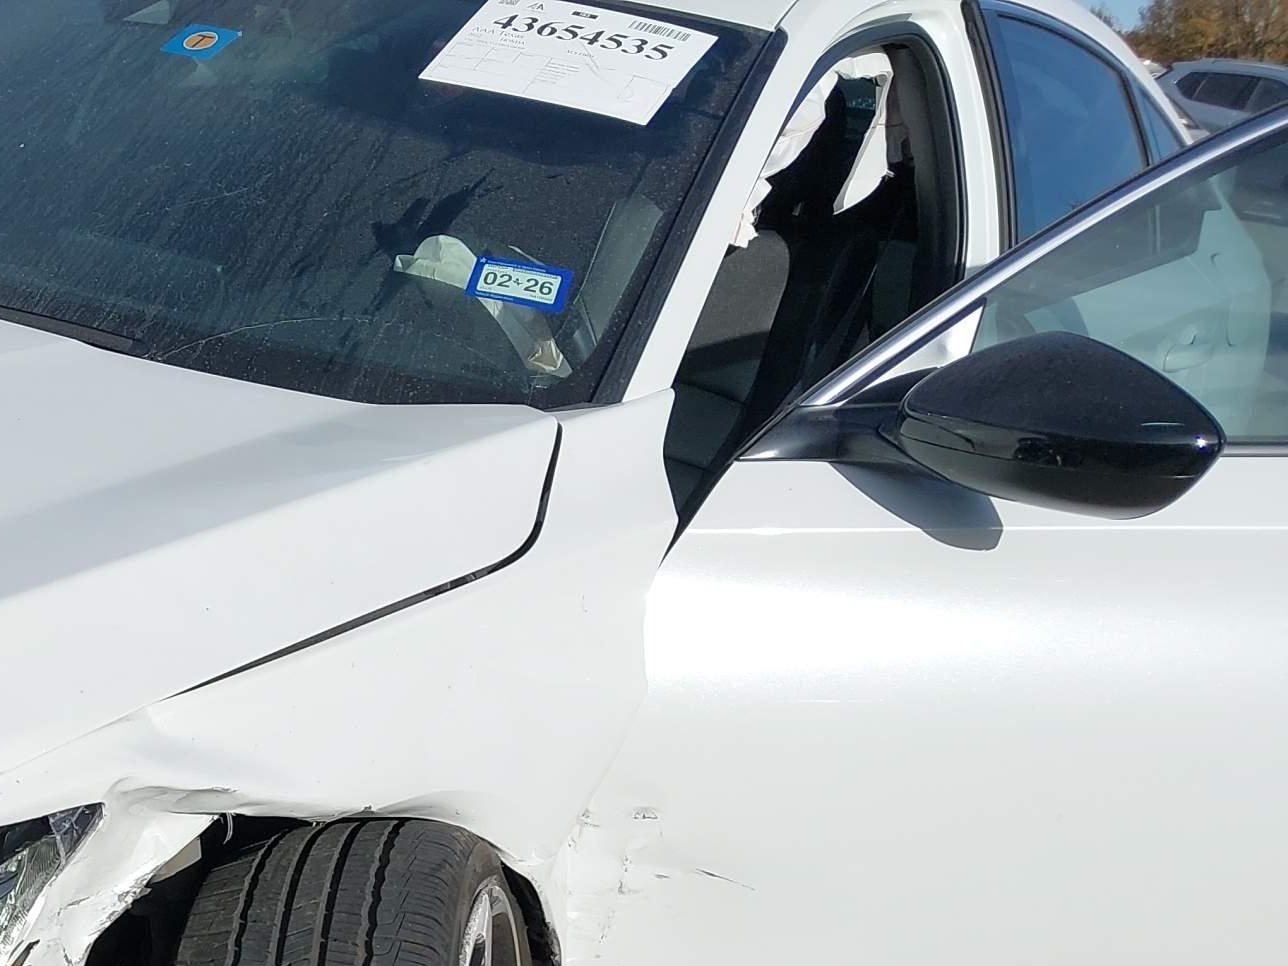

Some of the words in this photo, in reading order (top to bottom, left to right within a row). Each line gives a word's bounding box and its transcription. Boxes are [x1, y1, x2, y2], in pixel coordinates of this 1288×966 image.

[493, 14, 675, 60] 43654535
[483, 271, 513, 288] 02
[523, 278, 554, 296] 26
